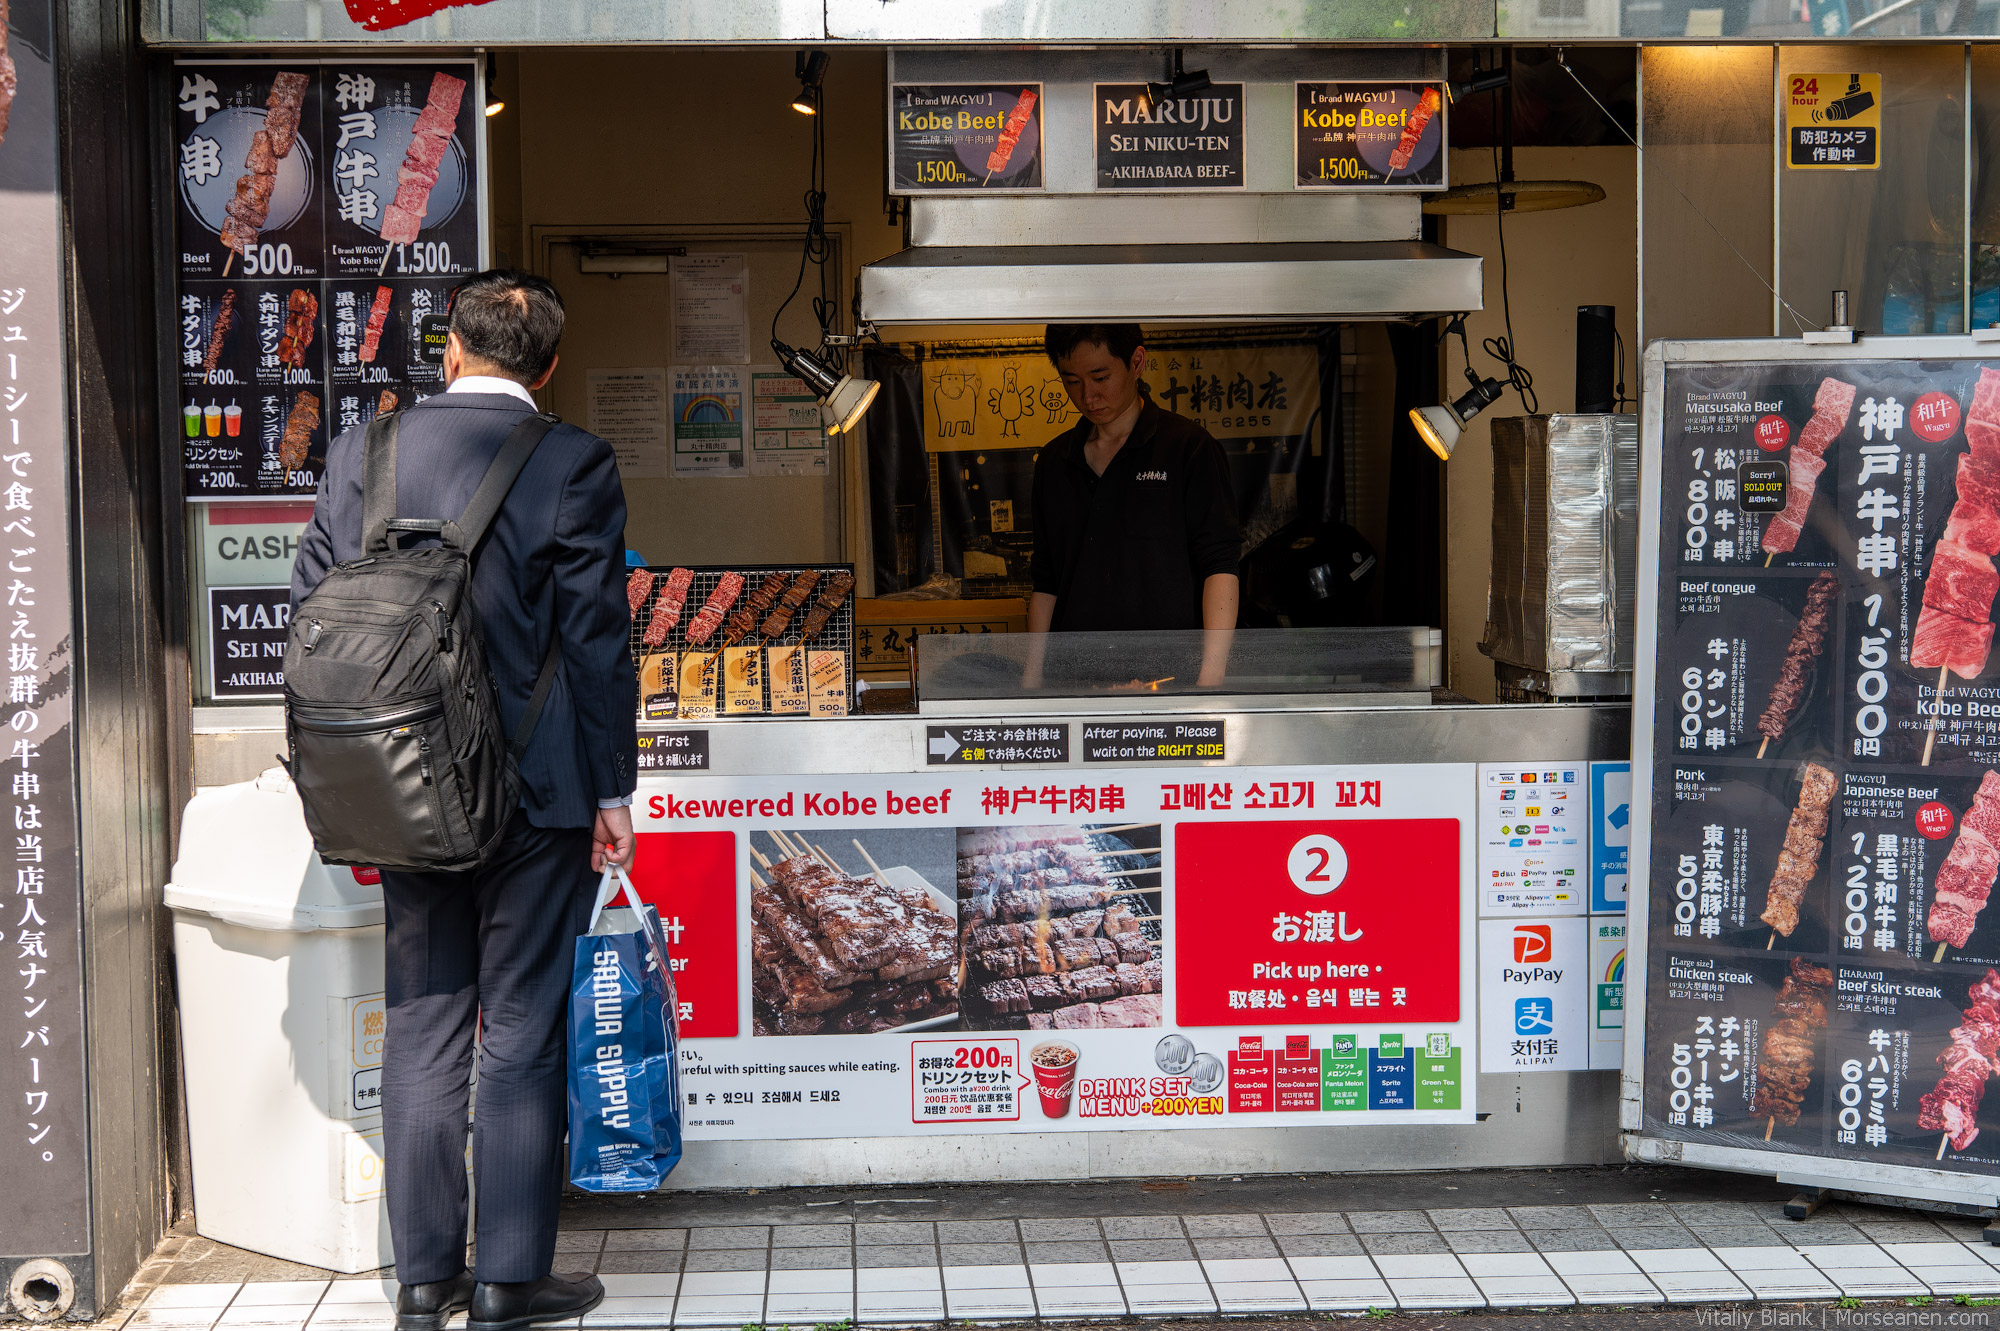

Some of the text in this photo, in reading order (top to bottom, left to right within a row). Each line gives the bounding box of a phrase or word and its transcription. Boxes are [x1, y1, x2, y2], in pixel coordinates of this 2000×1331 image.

[1792, 78, 1818, 95] 24
[1792, 97, 1819, 105] hour
[900, 110, 1005, 130] Kobe Beef
[1104, 98, 1234, 131] MARUJU
[1303, 108, 1408, 128] Kobe Beef
[178, 73, 222, 185] 牛串
[1144, 136, 1230, 151] NIKU-TEN
[1800, 130, 1867, 145] 防犯カメラ
[335, 73, 378, 225] 神戸牛串
[1812, 147, 1855, 161] 作動中
[183, 253, 210, 263] Beef
[340, 257, 361, 265] Kobe
[181, 294, 203, 367] 牛タン串
[258, 292, 280, 368] 大判牛タン串
[335, 291, 358, 366] 黒毛和牛串
[425, 335, 446, 344] SOLD
[208, 369, 240, 385] 600円
[283, 368, 316, 385] 1,000円
[361, 367, 394, 383] 1,200円
[1137, 371, 1288, 413] 十精肉店
[1685, 400, 1783, 414] Matsusaka Beef
[1917, 399, 1953, 422] 和牛
[261, 395, 281, 471] チキンステーキ串
[1758, 419, 1785, 437] 和牛
[1924, 422, 1951, 432] Wagyu
[1764, 437, 1783, 445] Wagyu
[1750, 471, 1776, 480] Sorry!
[1744, 483, 1782, 492] SOLD OUT
[1856, 397, 1905, 577] 神戸牛串
[1712, 448, 1736, 562] 松阪牛串
[1680, 582, 1756, 595] Beef tongue
[1697, 604, 1720, 613] 쇠고기
[220, 604, 290, 630] MAR
[745, 650, 758, 687] 牛タン串
[1705, 638, 1729, 751] 牛タン串
[1917, 700, 1962, 716] Kobe
[962, 728, 1061, 742] ご注文・お会計後は
[1084, 725, 1217, 740] After Please
[1937, 733, 1971, 746] 고베규
[656, 735, 689, 748] First
[961, 747, 1062, 761] 右側でお待ちください
[1092, 743, 1223, 758] wait on the RIGHT SIDE
[1675, 769, 1706, 781] Pork
[1159, 780, 1382, 811] 고베산 소고기 꼬치
[1843, 785, 1939, 800] Japanese Beef
[648, 788, 952, 819] Skewered Kobe beef
[1880, 810, 1904, 819] 쇠고기
[1920, 807, 1948, 824] 和牛
[1926, 825, 1947, 833] Wagyu
[1305, 847, 1330, 882] 2
[1700, 824, 1724, 939] 東京柔豚串
[1874, 834, 1898, 951] 黒毛和牛串
[1272, 910, 1363, 944] お渡し
[1252, 960, 1369, 982] Pick up here
[1503, 968, 1563, 984] PayPay
[1669, 967, 1753, 984] Chicken steak
[593, 950, 623, 1036] SANWA
[1348, 987, 1380, 1007] 받는
[1391, 987, 1407, 1007] 곳
[1669, 990, 1724, 1002] 닭고기 스테이크
[1838, 979, 1942, 999] Beef skirt steak
[1864, 1004, 1896, 1015] 스테이크
[1382, 1041, 1401, 1050] Sprite
[1510, 1039, 1558, 1056] 支付宝
[1718, 1016, 1740, 1083] チキン
[714, 1061, 900, 1076] with spitting sauces while eating.
[1515, 1057, 1554, 1065] ALIPAY
[922, 1070, 1012, 1085] ドリンクセット
[1693, 1016, 1716, 1128] ステーキ串
[596, 1044, 631, 1130] SUPPLY
[924, 1086, 949, 1094] Combo
[1079, 1076, 1191, 1098] DRINK SET
[1865, 1028, 1891, 1147] 牛ハラミ串
[705, 1090, 841, 1105] 수 있으니 조심해서 드세요
[924, 1094, 958, 1104] 200日元
[949, 1105, 972, 1114] 200엔
